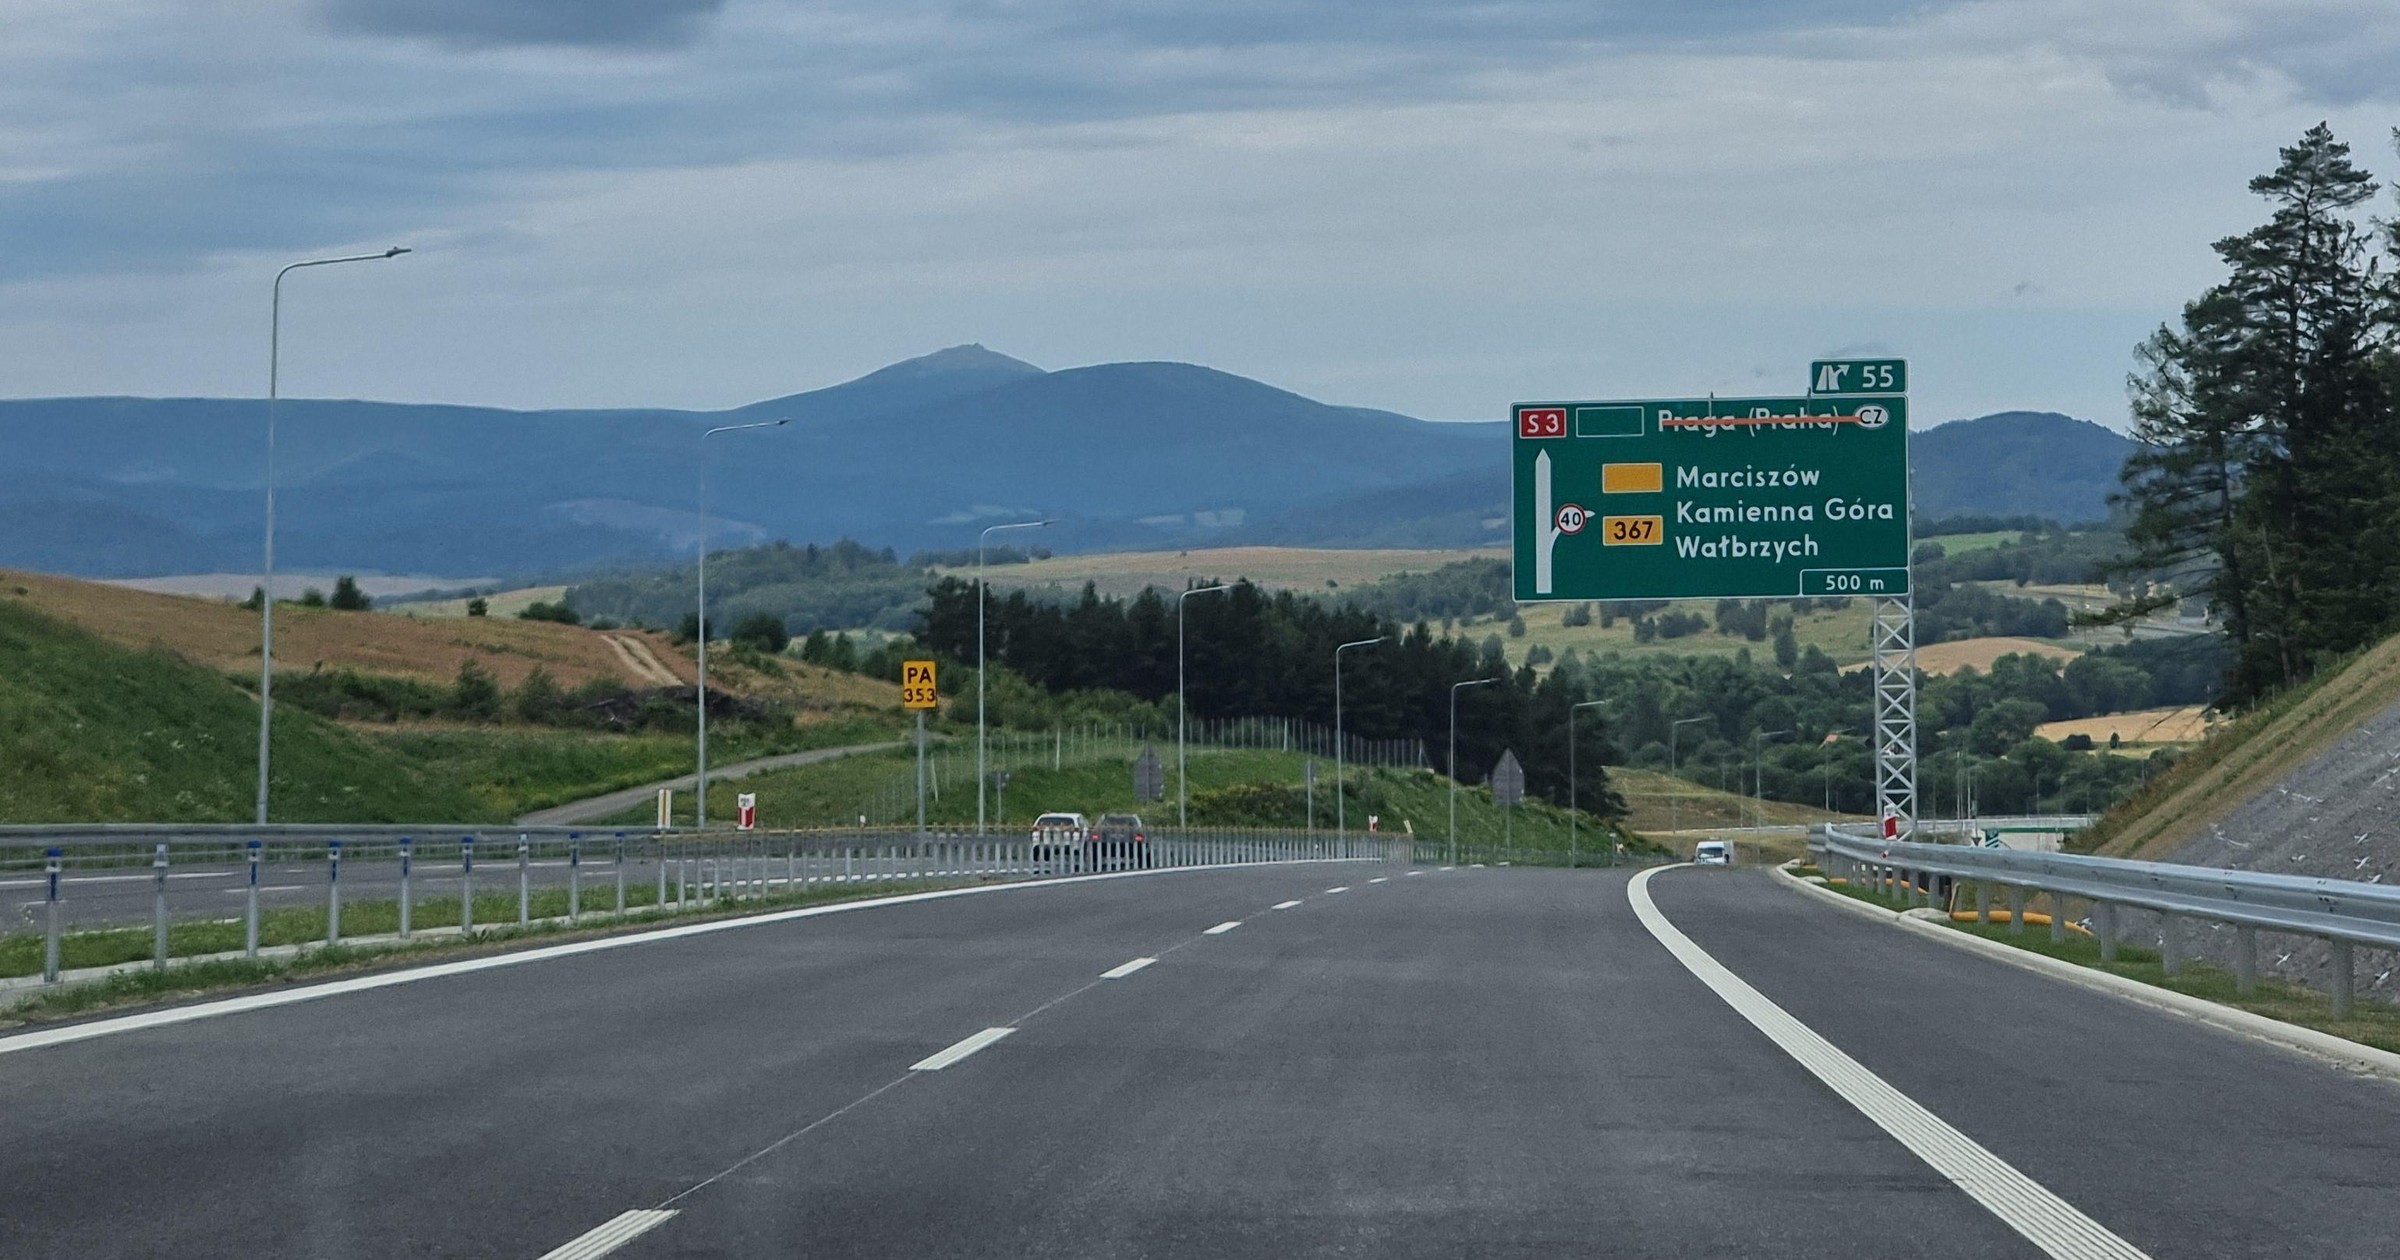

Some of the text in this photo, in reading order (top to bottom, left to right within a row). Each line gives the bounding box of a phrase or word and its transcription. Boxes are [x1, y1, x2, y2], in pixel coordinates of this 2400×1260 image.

[1862, 365, 1894, 388] 55
[1657, 406, 1839, 438] Praga (Praha)
[1859, 409, 1883, 424] CZ
[1677, 464, 1820, 488] Marciszów
[1560, 511, 1582, 527] 40
[1677, 497, 1893, 523] Kamienna Góra
[1613, 520, 1654, 540] 367
[1676, 534, 1818, 563] Wałbrzych
[1825, 574, 1884, 590] 500 m
[907, 667, 932, 684] PA
[904, 688, 935, 703] 353
